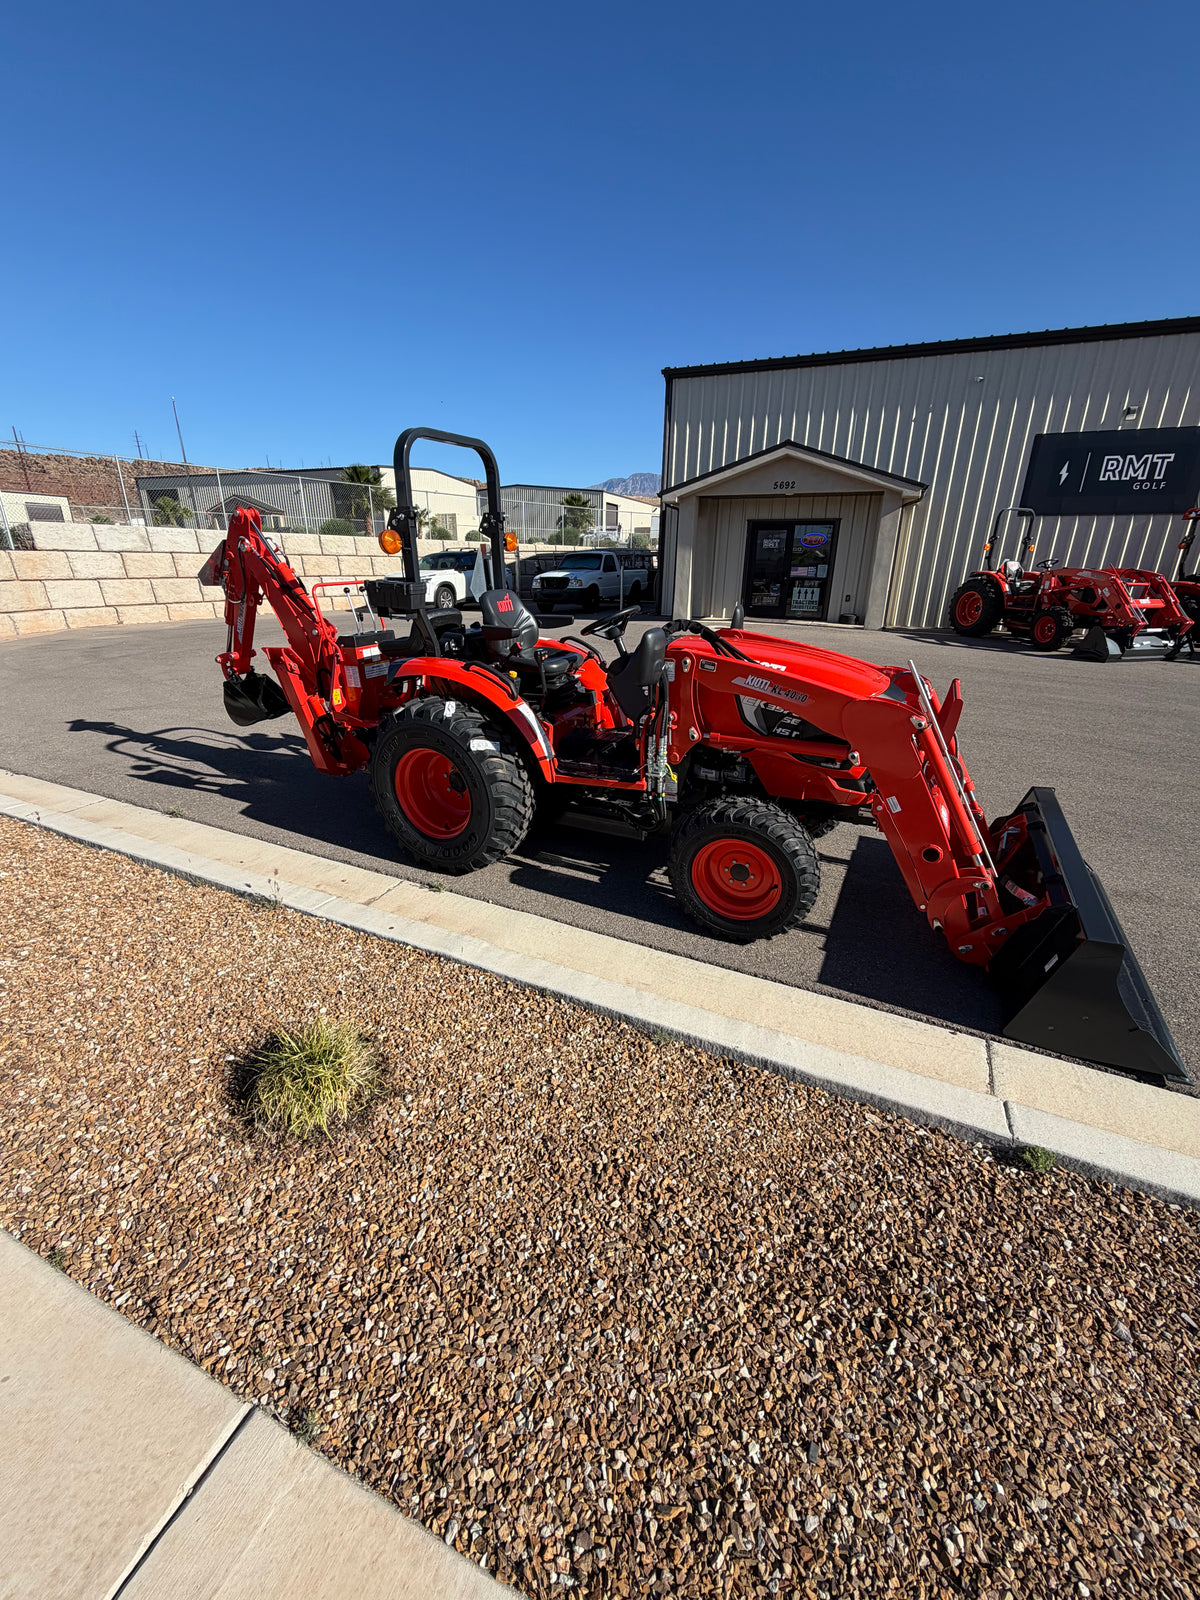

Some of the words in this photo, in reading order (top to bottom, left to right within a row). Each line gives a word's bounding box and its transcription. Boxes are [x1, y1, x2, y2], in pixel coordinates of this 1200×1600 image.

[1099, 453, 1175, 481] RMT
[773, 481, 796, 490] 5692
[1132, 482, 1167, 490] GOLF
[802, 535, 825, 545] OPEN
[745, 674, 771, 690] KIOTI
[771, 684, 783, 693] KL
[782, 716, 802, 726] SE
